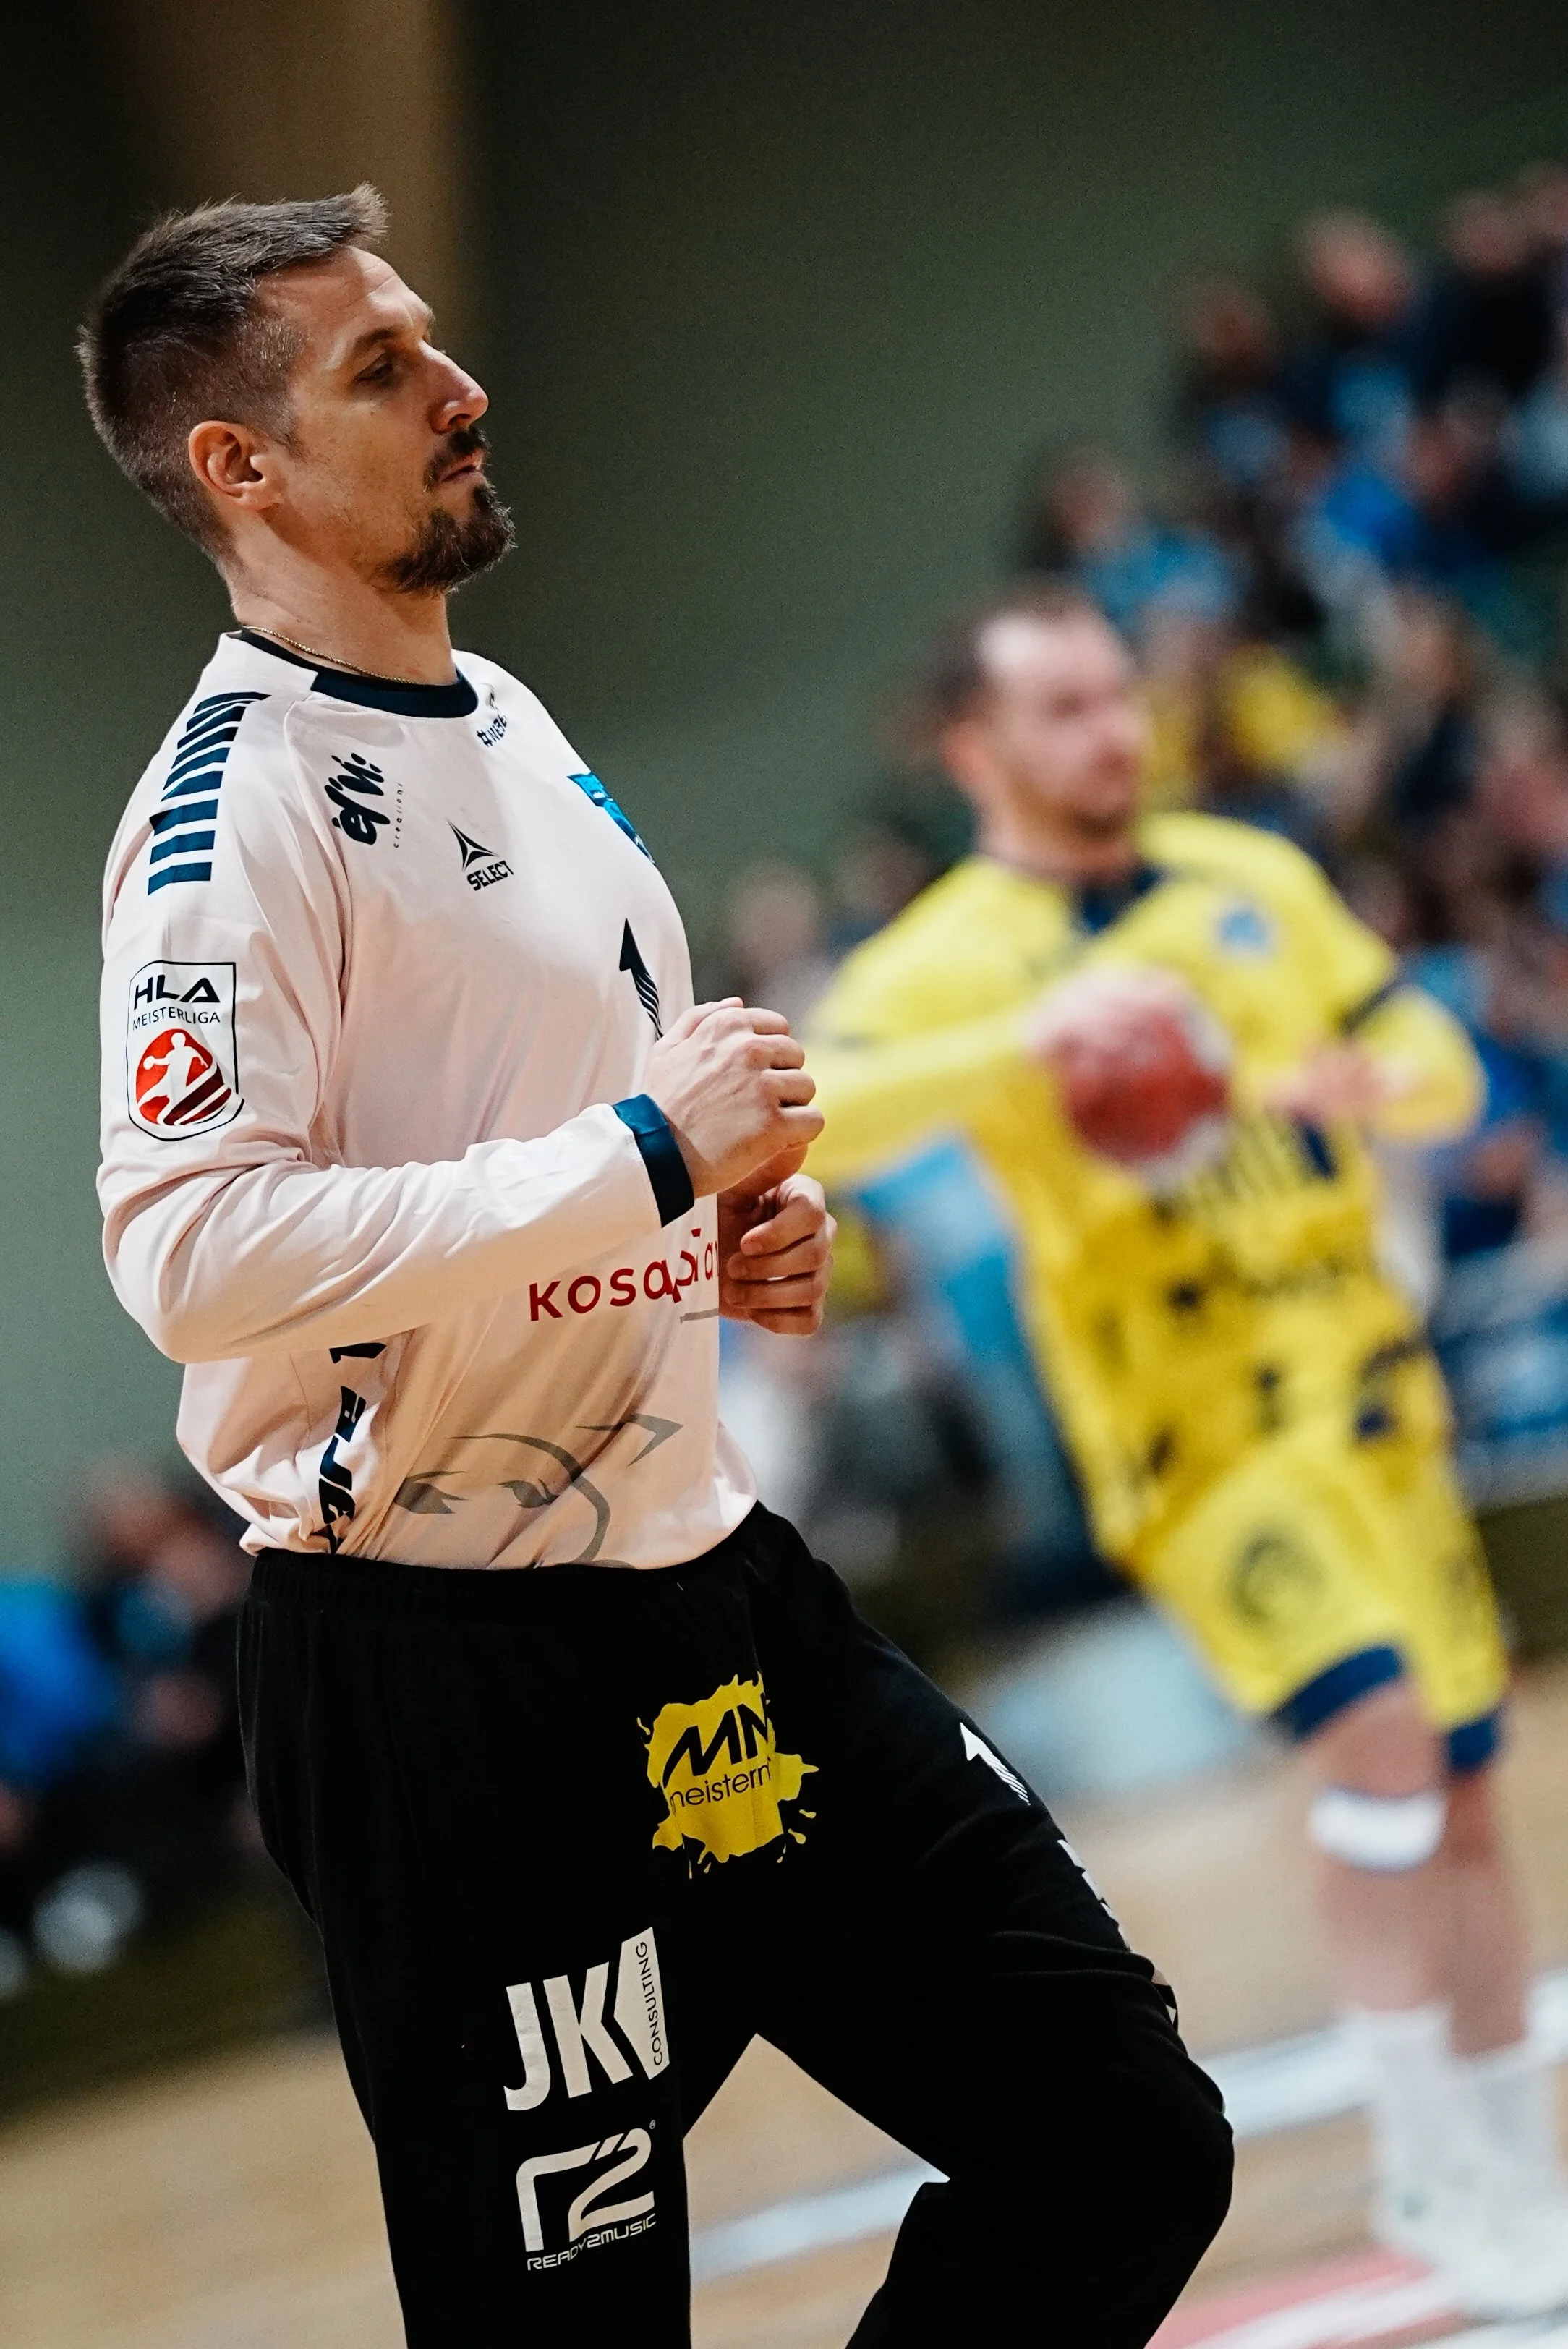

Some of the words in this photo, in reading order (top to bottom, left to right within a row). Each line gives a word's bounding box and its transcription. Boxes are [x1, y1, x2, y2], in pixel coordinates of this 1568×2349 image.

[466, 860, 514, 891] SELECT
[134, 974, 221, 1010] HLA
[132, 1006, 221, 1031] MEISTERLIGA
[636, 1941, 663, 2066] CONSULTING
[527, 2212, 657, 2271] READY2MUSIC
